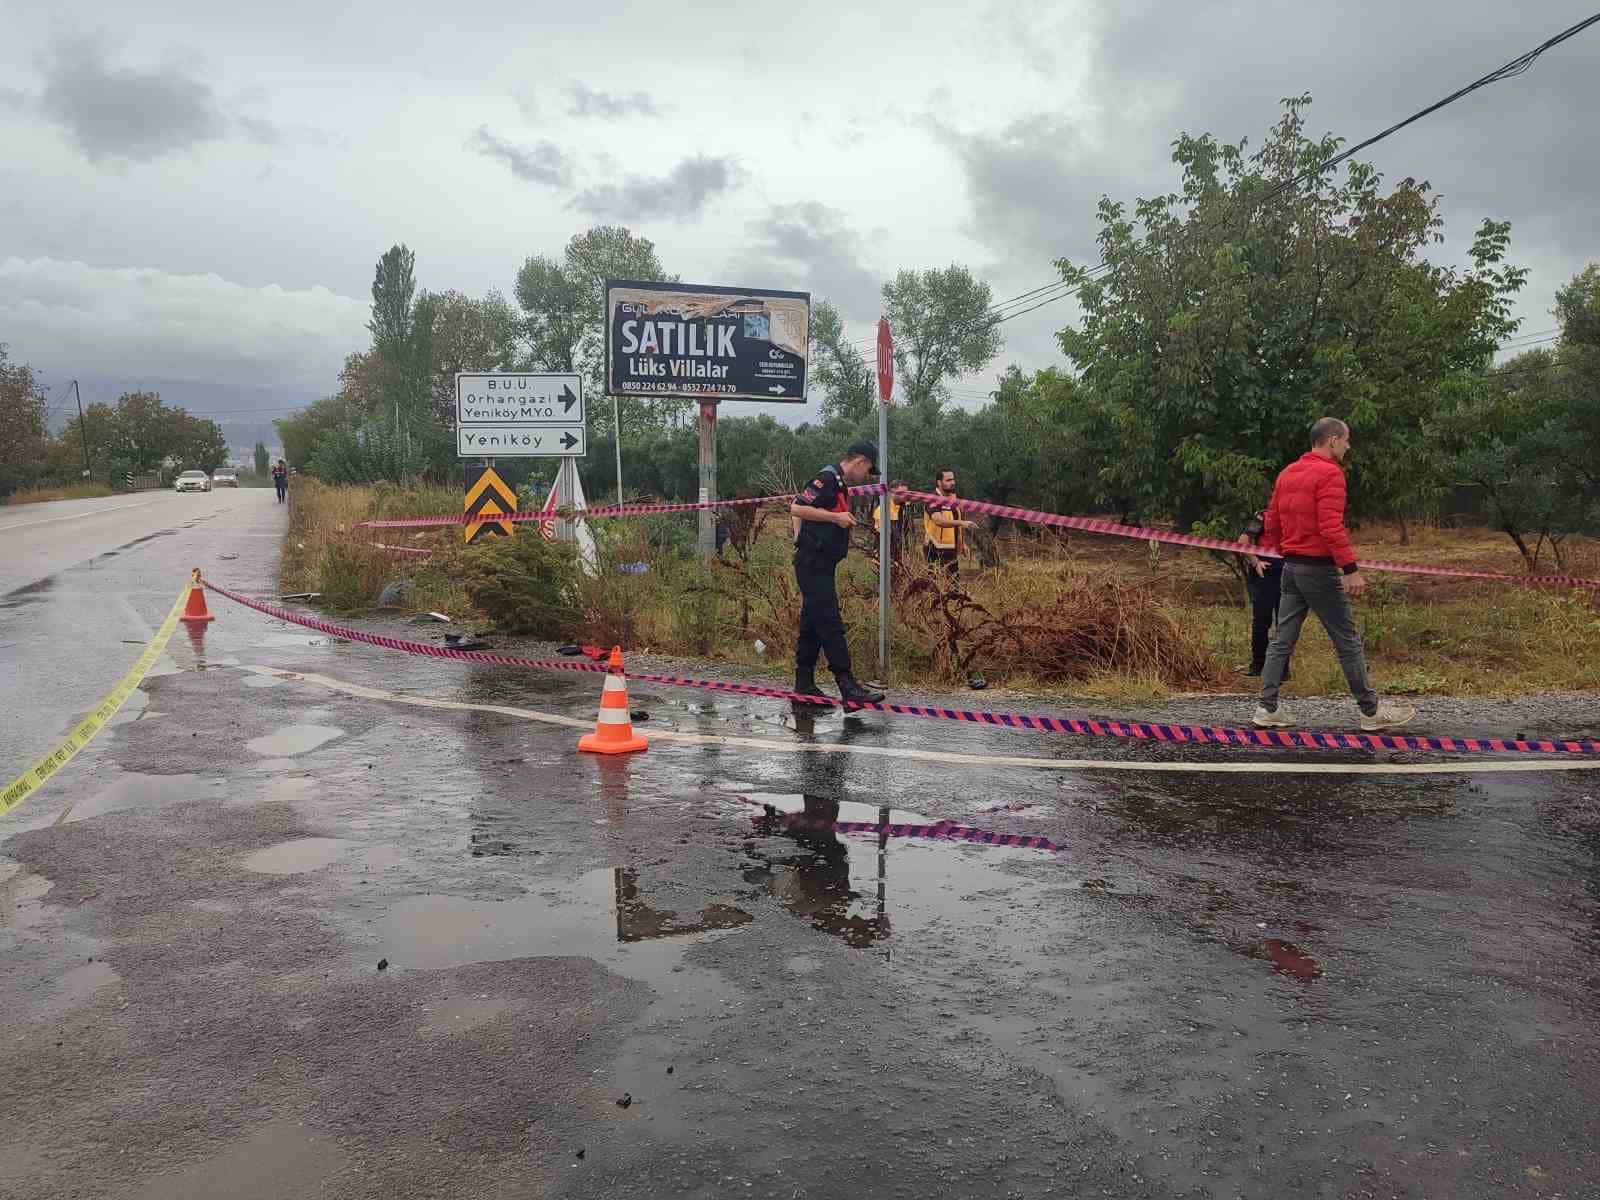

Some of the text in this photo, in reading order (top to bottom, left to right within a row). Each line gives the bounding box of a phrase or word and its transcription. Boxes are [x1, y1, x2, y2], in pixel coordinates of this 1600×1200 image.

[622, 320, 736, 357] SATILIK
[629, 357, 729, 378] Lüks Villalar
[622, 381, 641, 390] 0850
[467, 393, 551, 405] Orhangazi
[464, 407, 518, 419] Yeniköy
[465, 433, 542, 448] Yeniköy
